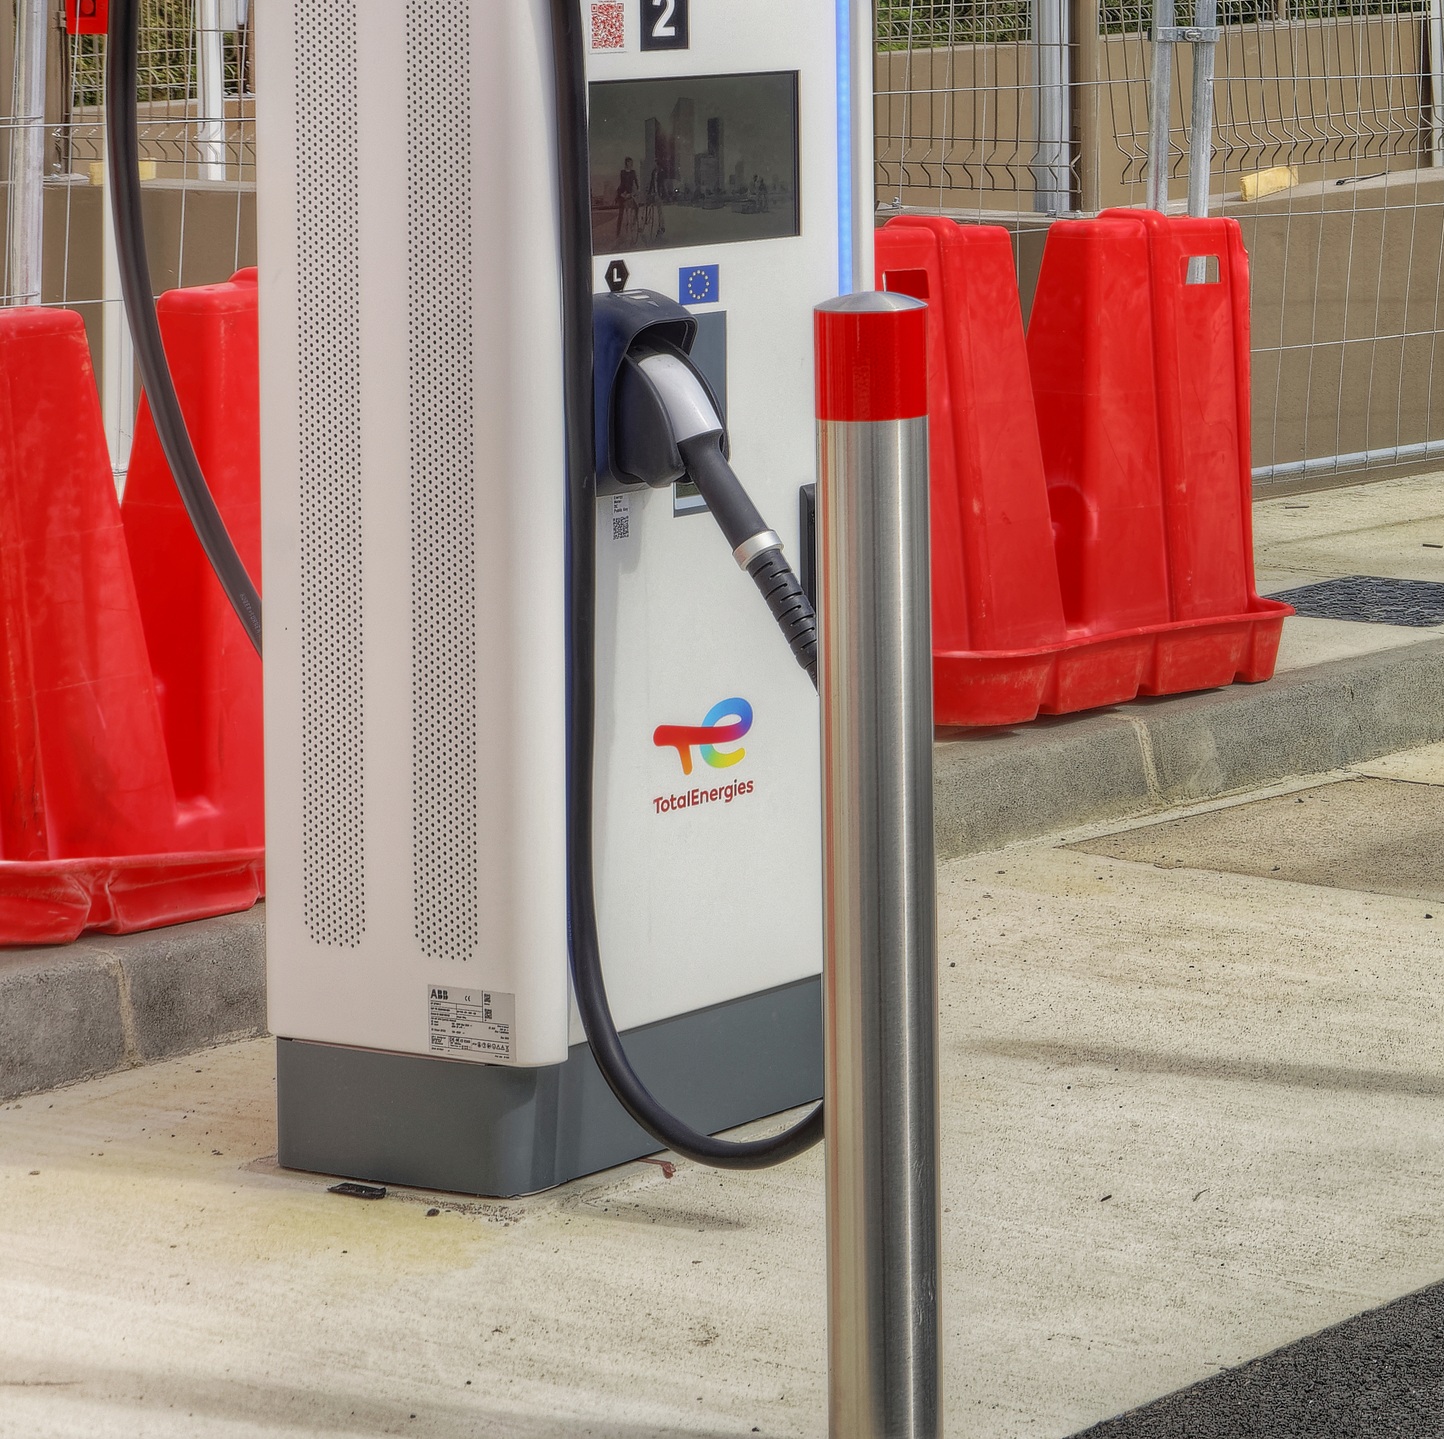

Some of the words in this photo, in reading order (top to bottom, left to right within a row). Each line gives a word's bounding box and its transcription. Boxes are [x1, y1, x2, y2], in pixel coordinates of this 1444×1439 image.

[613, 268, 621, 282] L
[653, 777, 754, 814] TotalEnergies
[430, 989, 448, 1000] ABB
